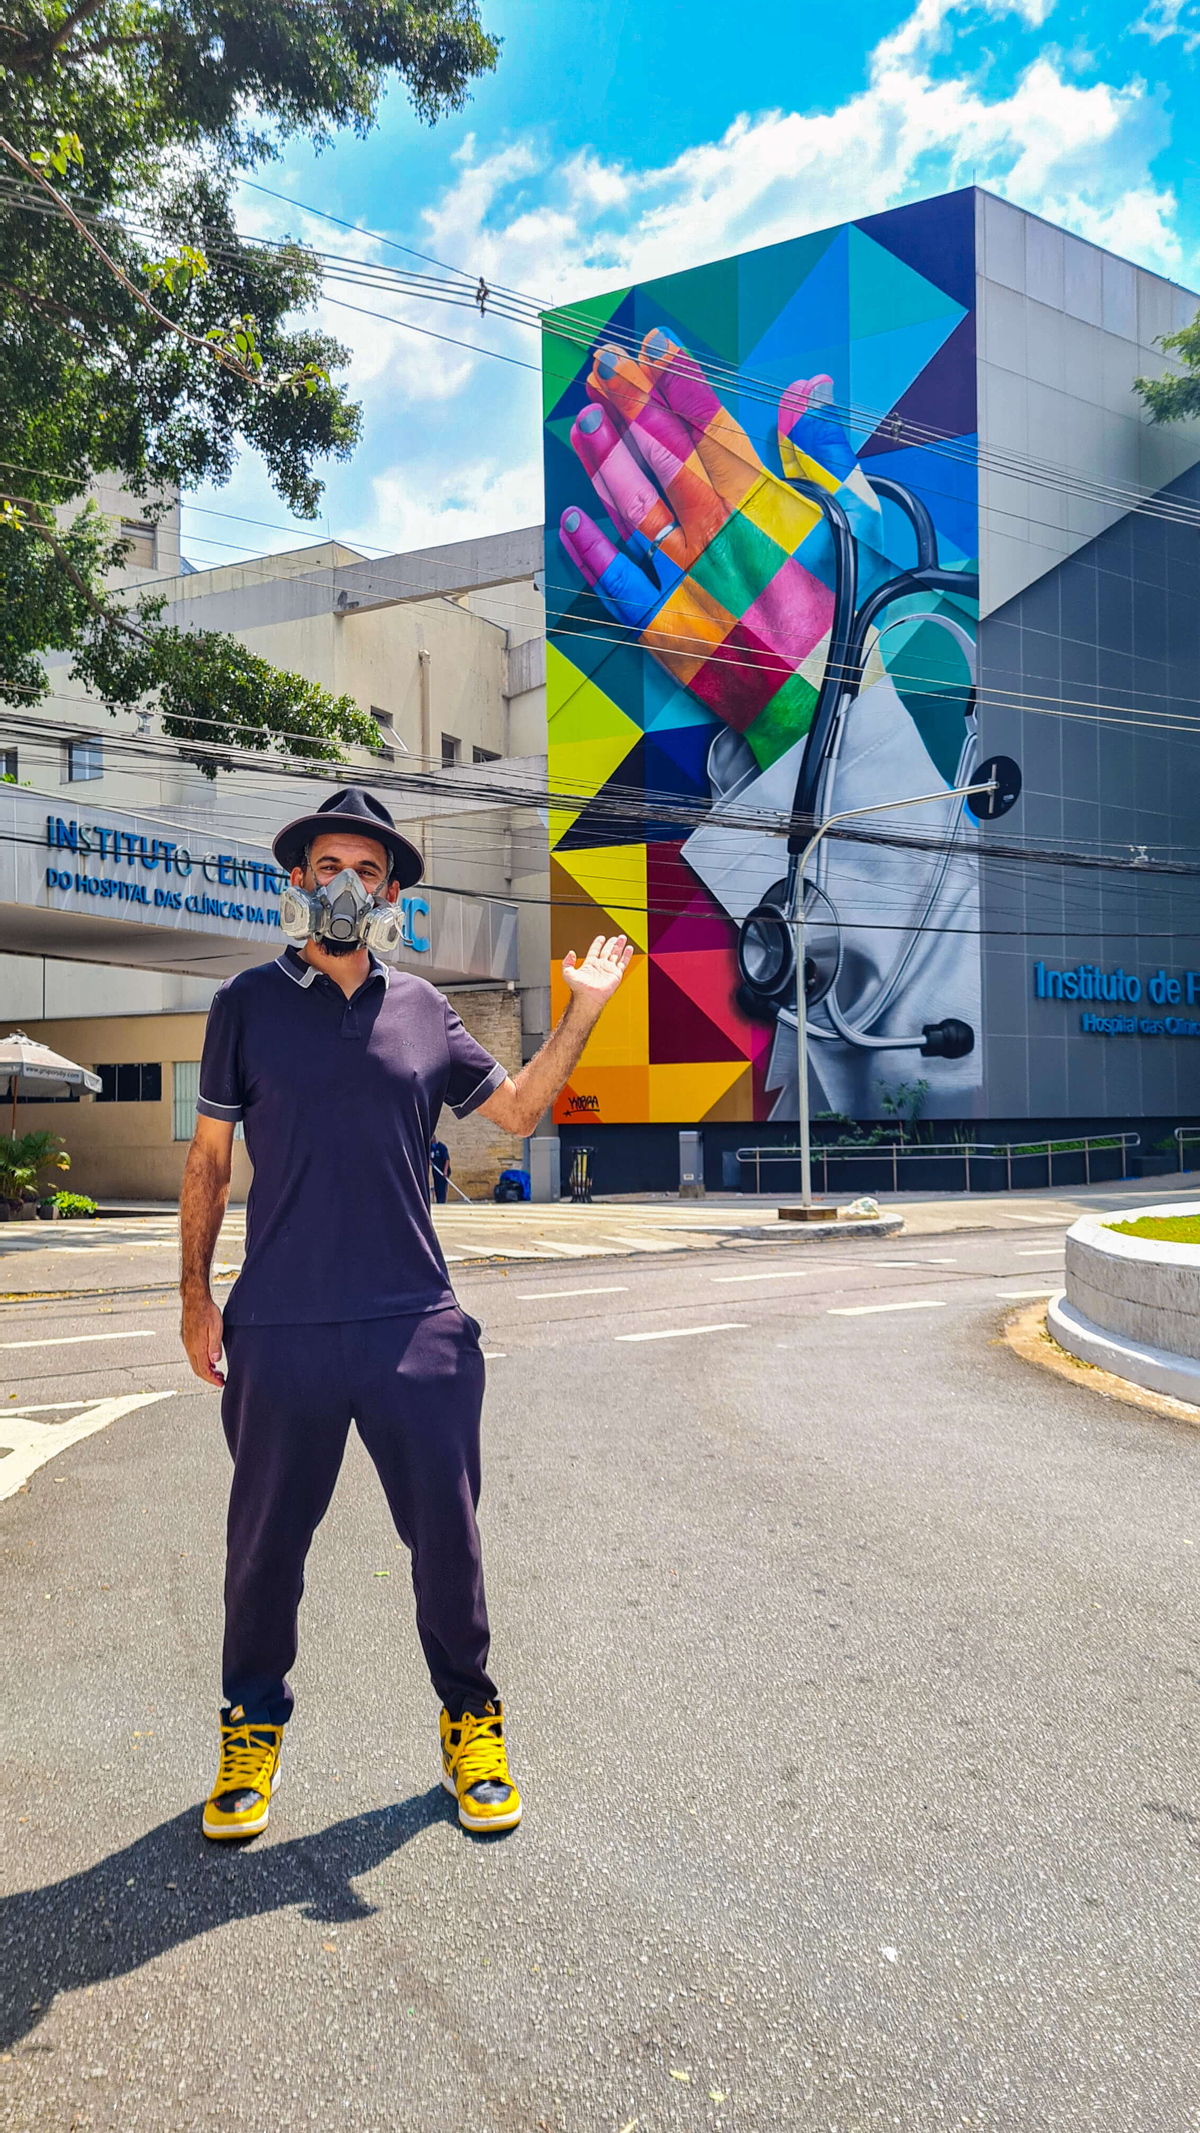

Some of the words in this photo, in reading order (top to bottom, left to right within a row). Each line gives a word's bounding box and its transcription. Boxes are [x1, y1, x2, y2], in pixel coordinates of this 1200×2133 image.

[47, 816, 192, 877] INSTITUTO
[203, 851, 291, 895] CENTRA
[46, 868, 73, 890] DO
[75, 874, 152, 905] HOSPITAL
[154, 889, 183, 911] DAS
[185, 892, 245, 920] CLÍNICAS
[246, 905, 265, 925] DA
[1034, 961, 1141, 1002] Instituto
[1148, 969, 1182, 1004] de
[1081, 1012, 1138, 1038] Hospital
